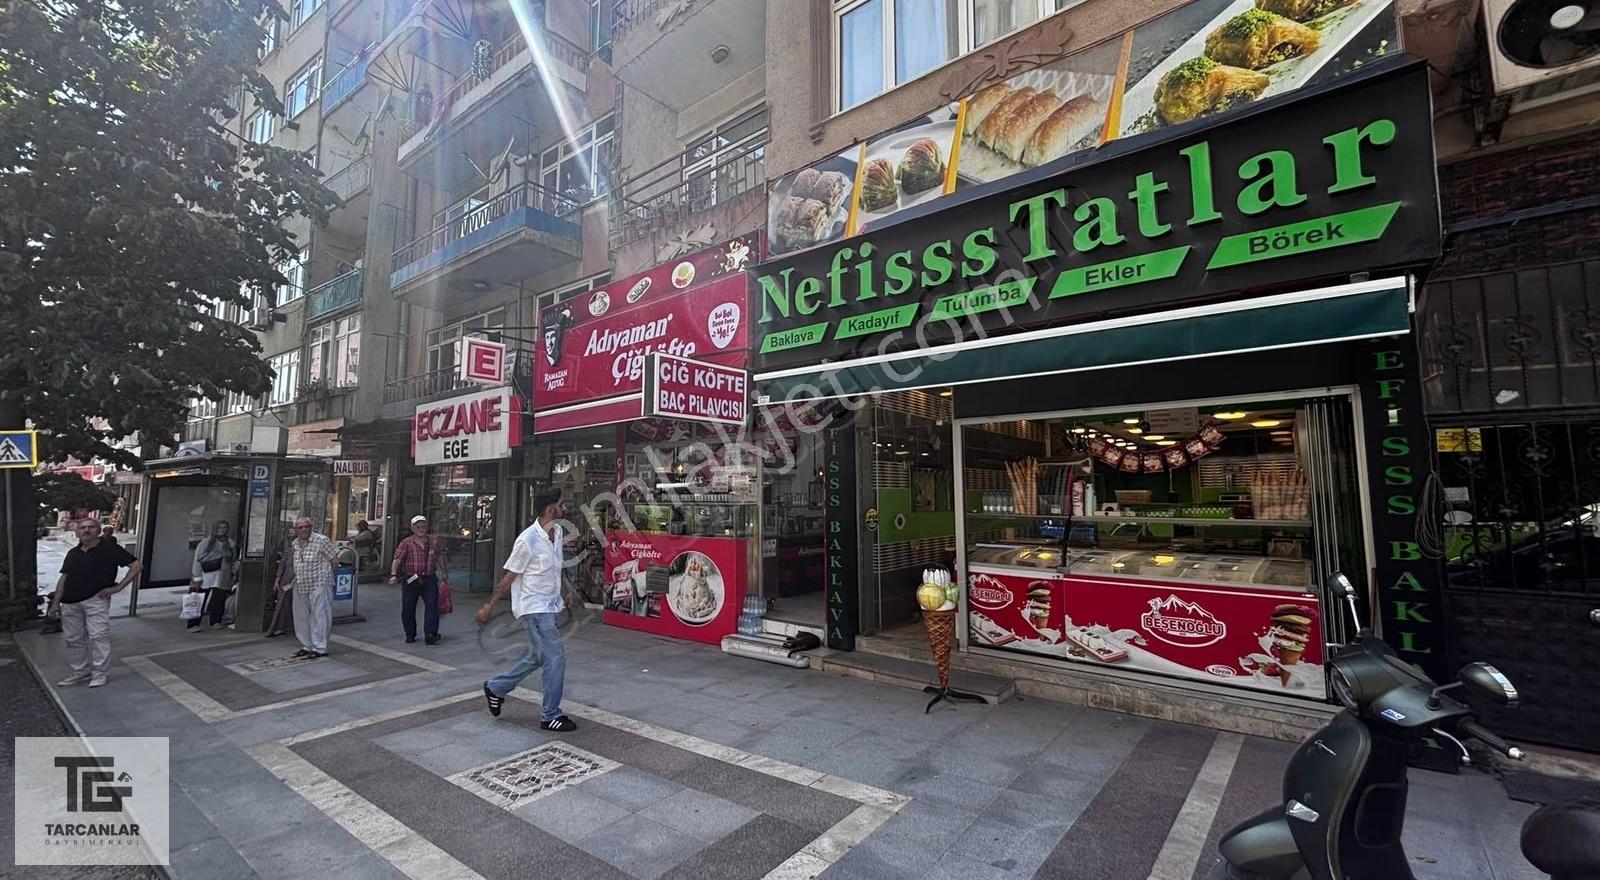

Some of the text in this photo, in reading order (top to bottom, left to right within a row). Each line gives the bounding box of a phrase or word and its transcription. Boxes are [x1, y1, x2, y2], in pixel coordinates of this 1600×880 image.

[758, 119, 1396, 324] Nefisss Tatlar
[1249, 220, 1344, 255] Börek
[1085, 263, 1146, 286] Ekler
[942, 285, 1021, 313] Tulumba
[848, 311, 900, 332] Kadayıf
[583, 318, 669, 357] Adıyaman
[770, 329, 814, 349] Baklava
[473, 347, 496, 377] E
[611, 337, 696, 386] Çiğfte
[660, 360, 744, 394] ÇİĞ KÖFTE
[660, 389, 686, 414] BAÇ
[416, 395, 502, 442] ECZANE
[443, 439, 469, 460] EGE
[335, 461, 369, 473] NALBUR
[830, 521, 844, 641] BAKLAVA
[1391, 541, 1434, 674] BAKL
[1145, 616, 1222, 636] BEŞENOĞLU
